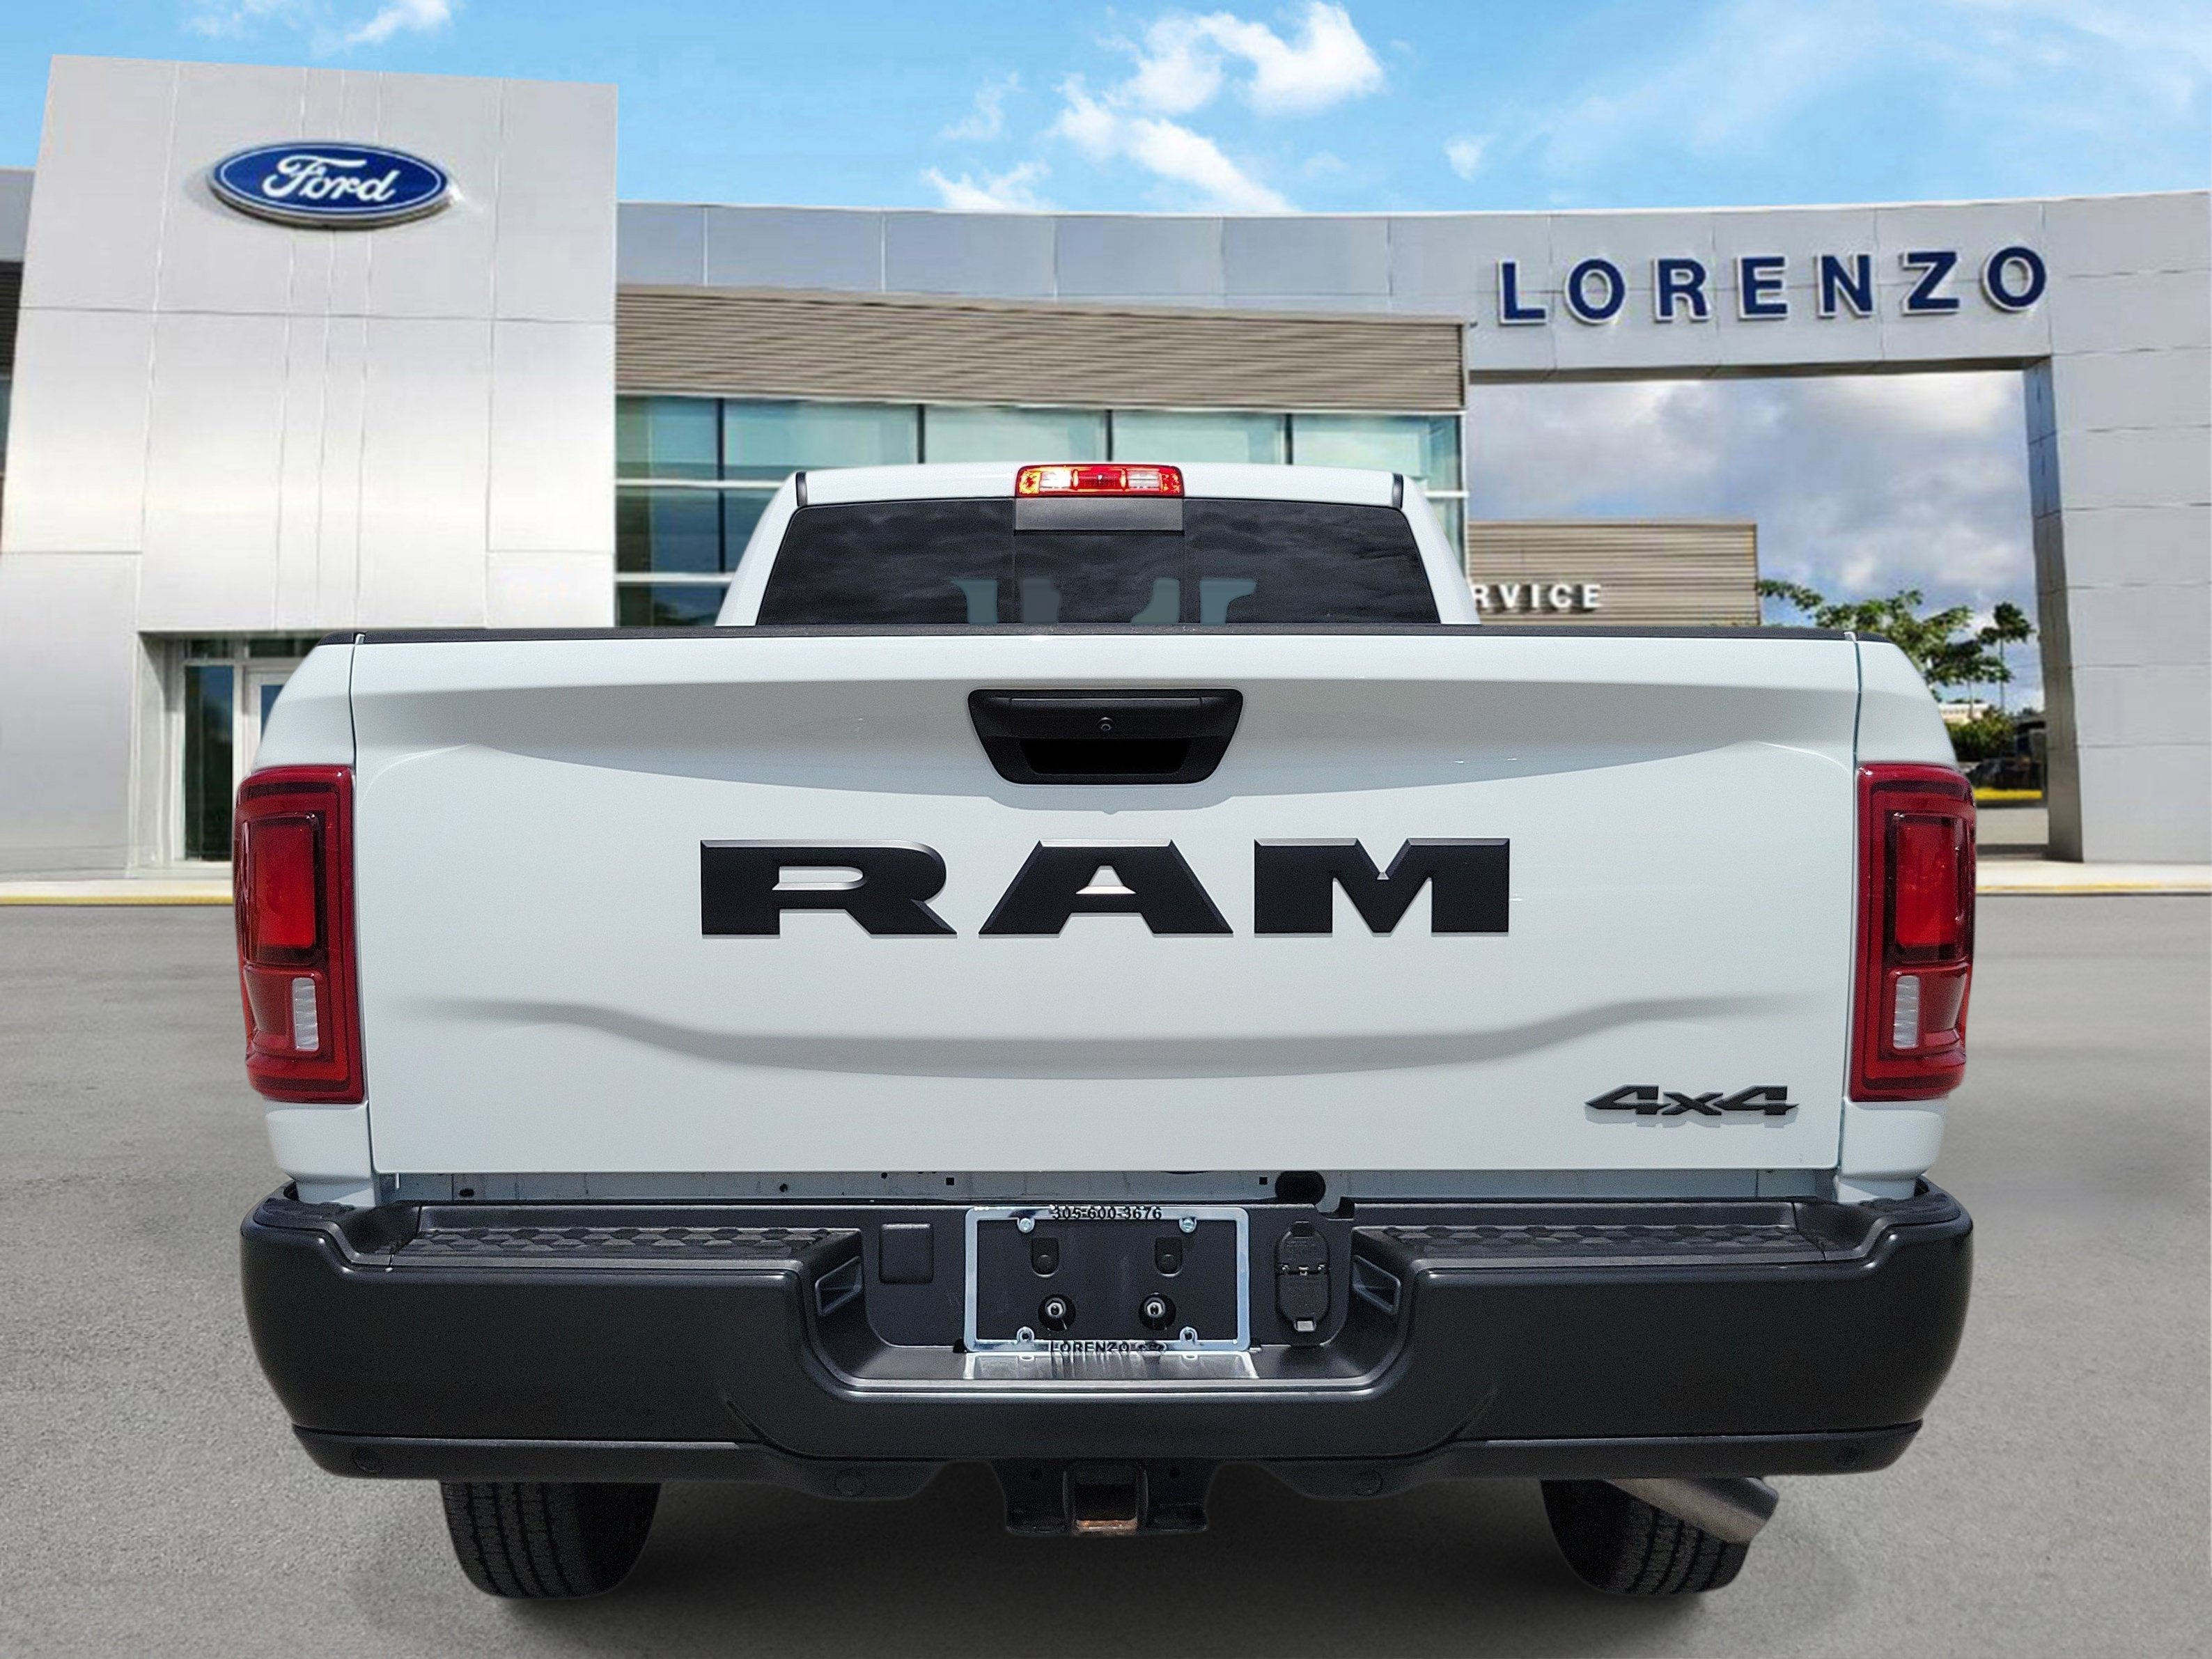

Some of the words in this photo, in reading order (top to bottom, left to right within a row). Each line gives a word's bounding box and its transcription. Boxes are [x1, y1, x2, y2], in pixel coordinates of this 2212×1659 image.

[261, 154, 401, 201] Ford
[1497, 246, 2047, 324] LORENZO
[701, 839, 1510, 936] RAM
[1584, 1084, 1800, 1116] 4x4
[1049, 1204, 1162, 1220] 305-600-3676
[1050, 1340, 1130, 1353] LORENZO
